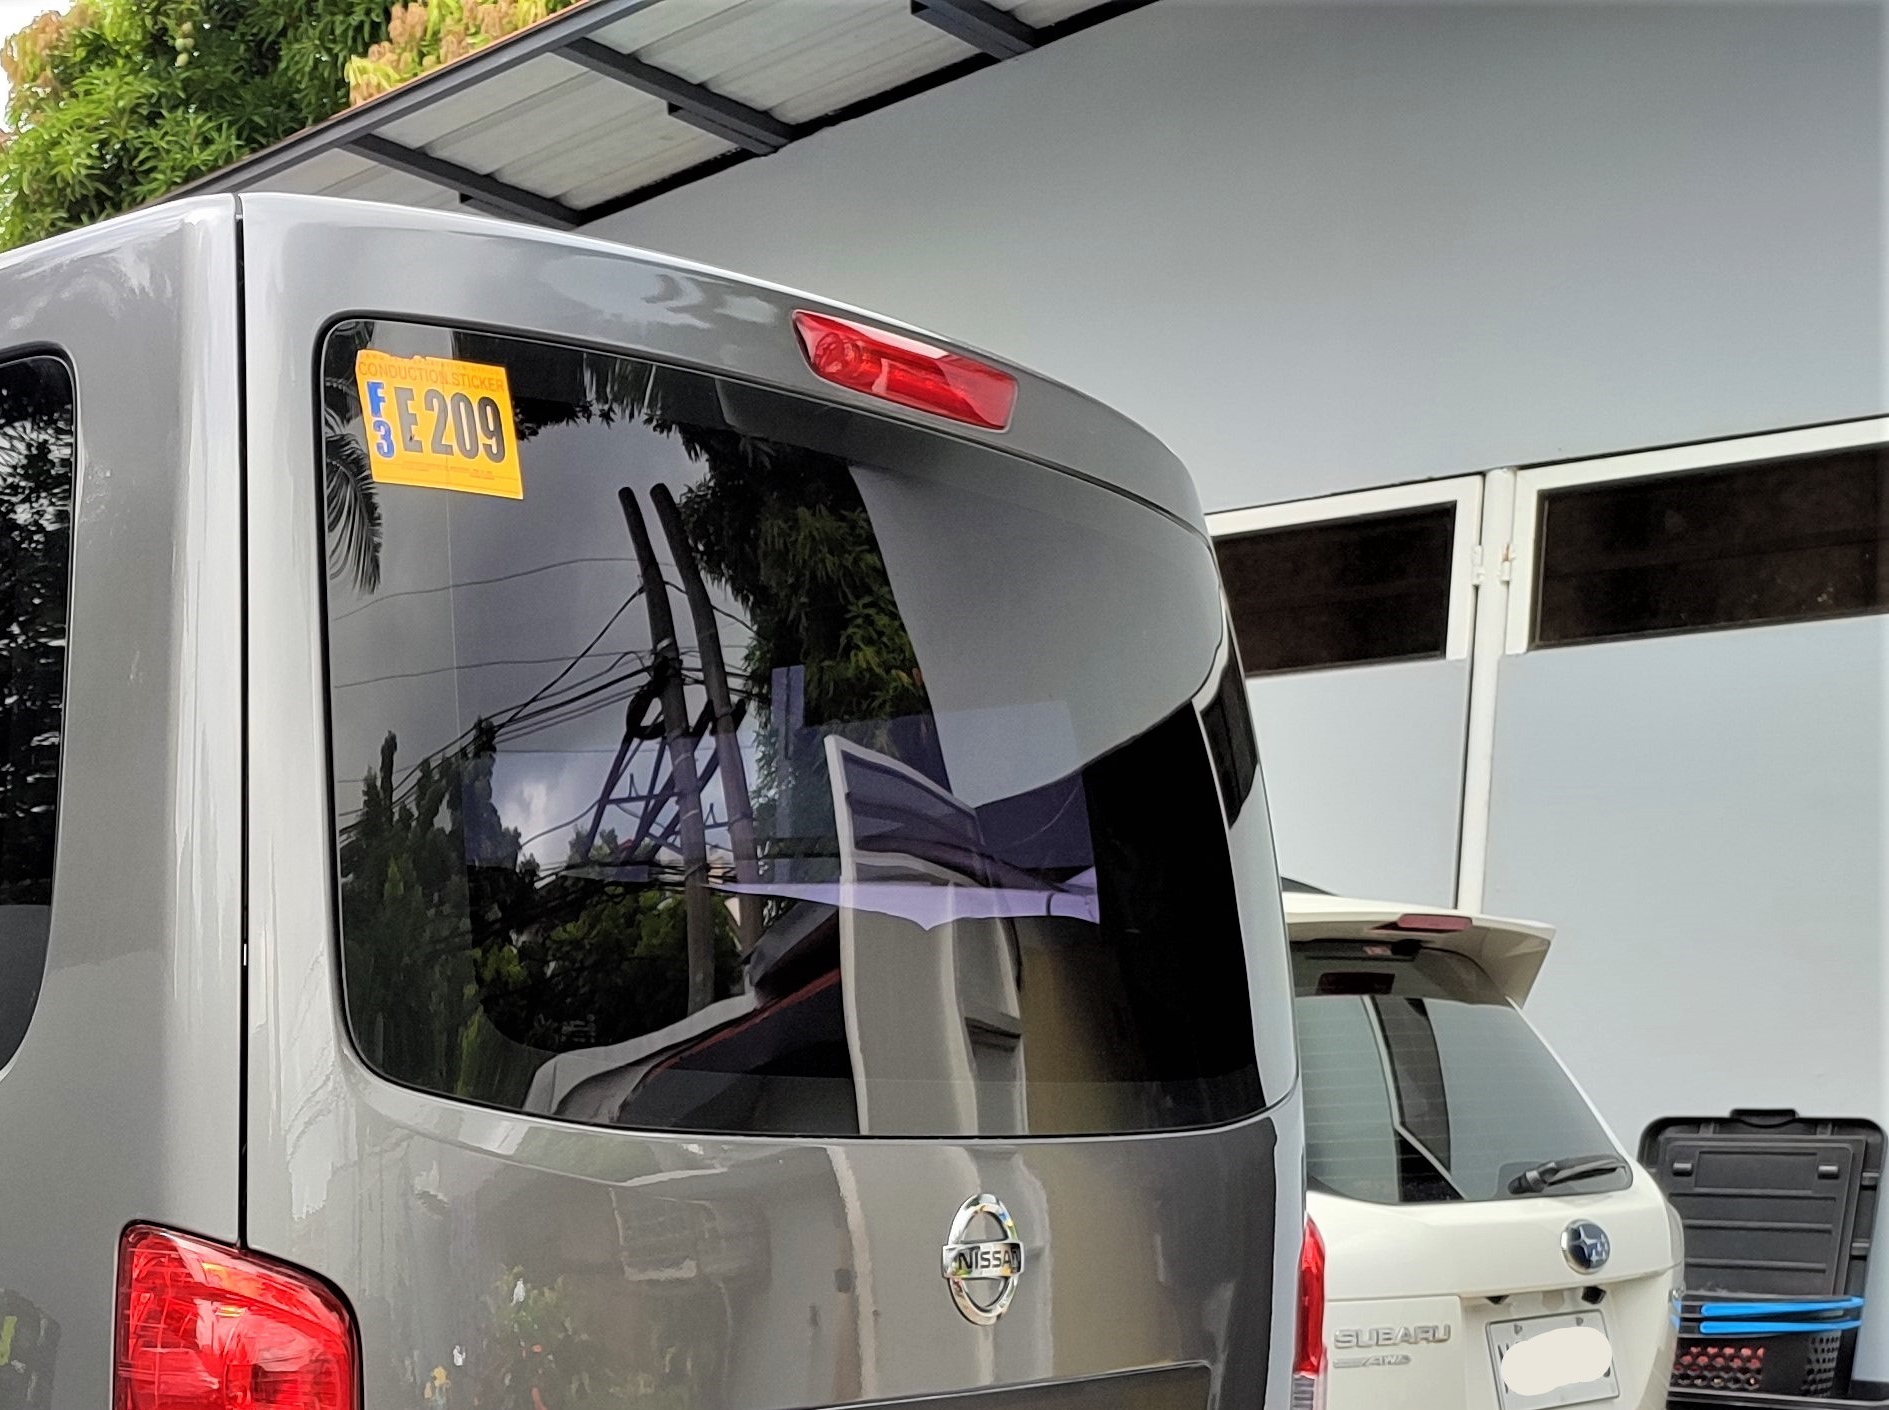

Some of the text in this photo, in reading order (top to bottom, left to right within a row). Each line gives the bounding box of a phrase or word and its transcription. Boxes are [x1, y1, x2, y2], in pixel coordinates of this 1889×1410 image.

[358, 362, 449, 385] CONDUCTION
[450, 373, 505, 393] STICKER
[957, 1247, 1021, 1273] NISSAN
[1333, 1323, 1452, 1350] SUBARU
